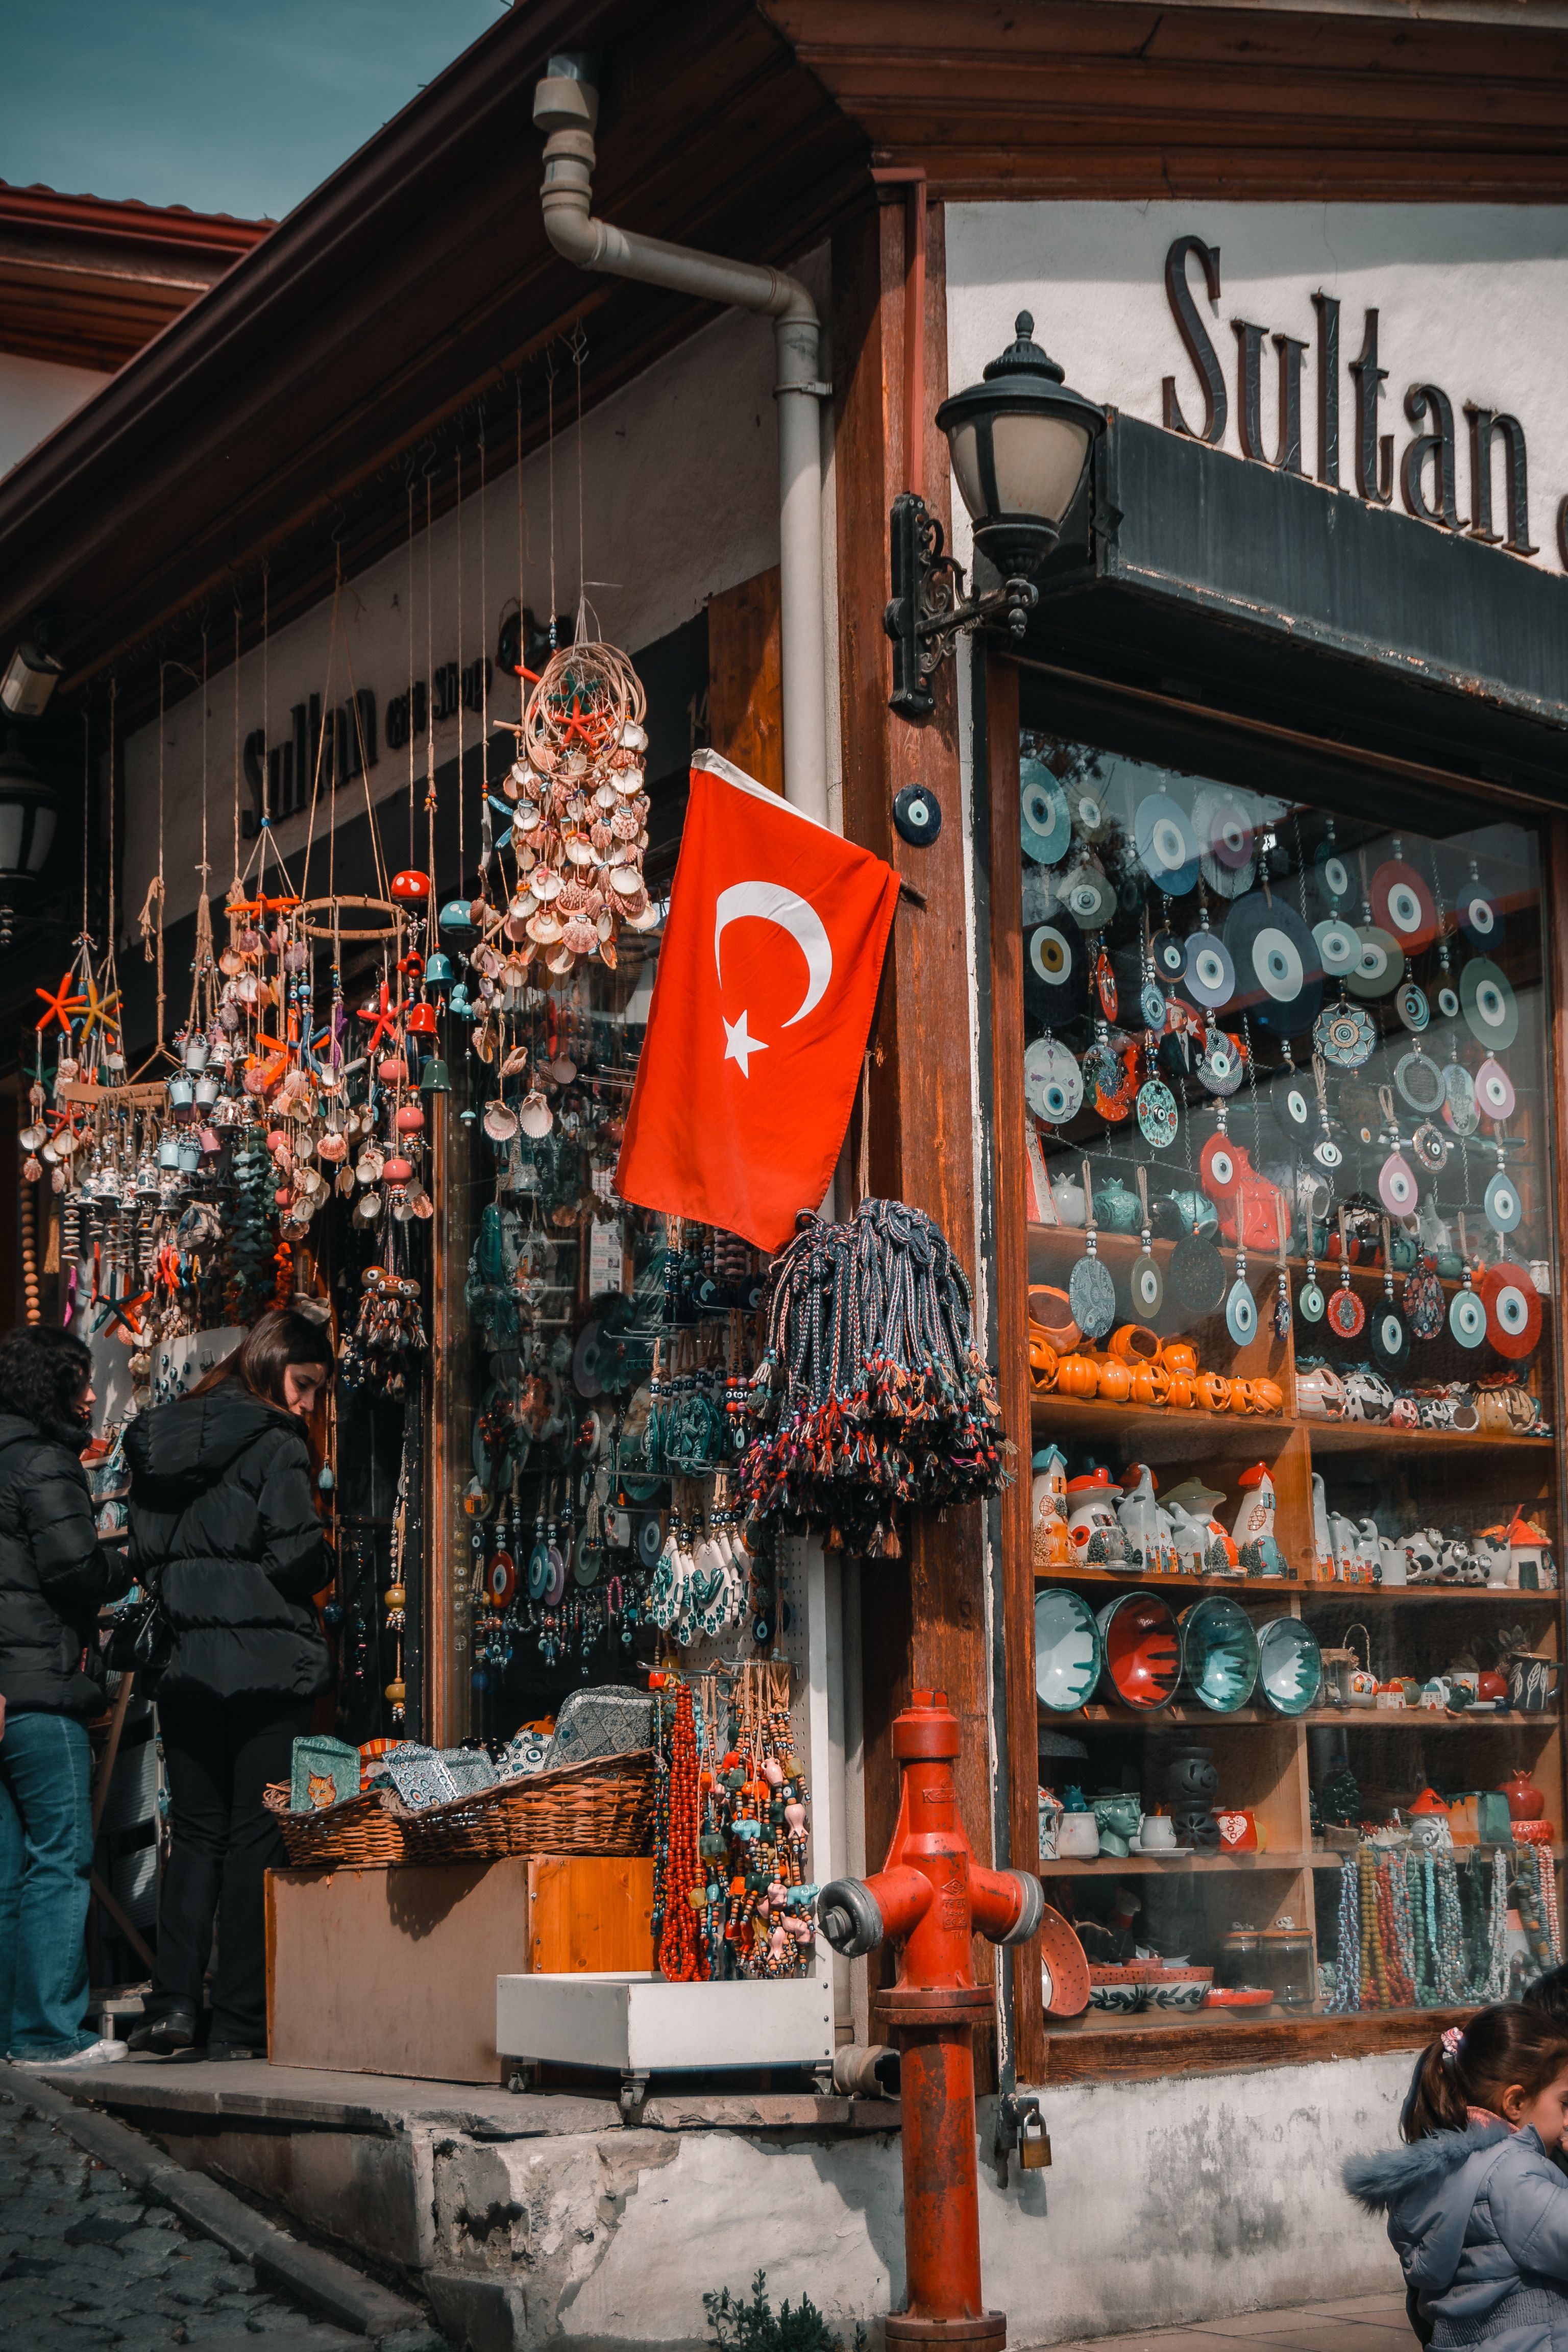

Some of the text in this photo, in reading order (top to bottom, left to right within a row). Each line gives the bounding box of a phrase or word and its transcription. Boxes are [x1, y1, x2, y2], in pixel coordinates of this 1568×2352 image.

[1162, 235, 1540, 556] Sultan
[242, 690, 379, 838] Sultan
[432, 658, 493, 721] Shop
